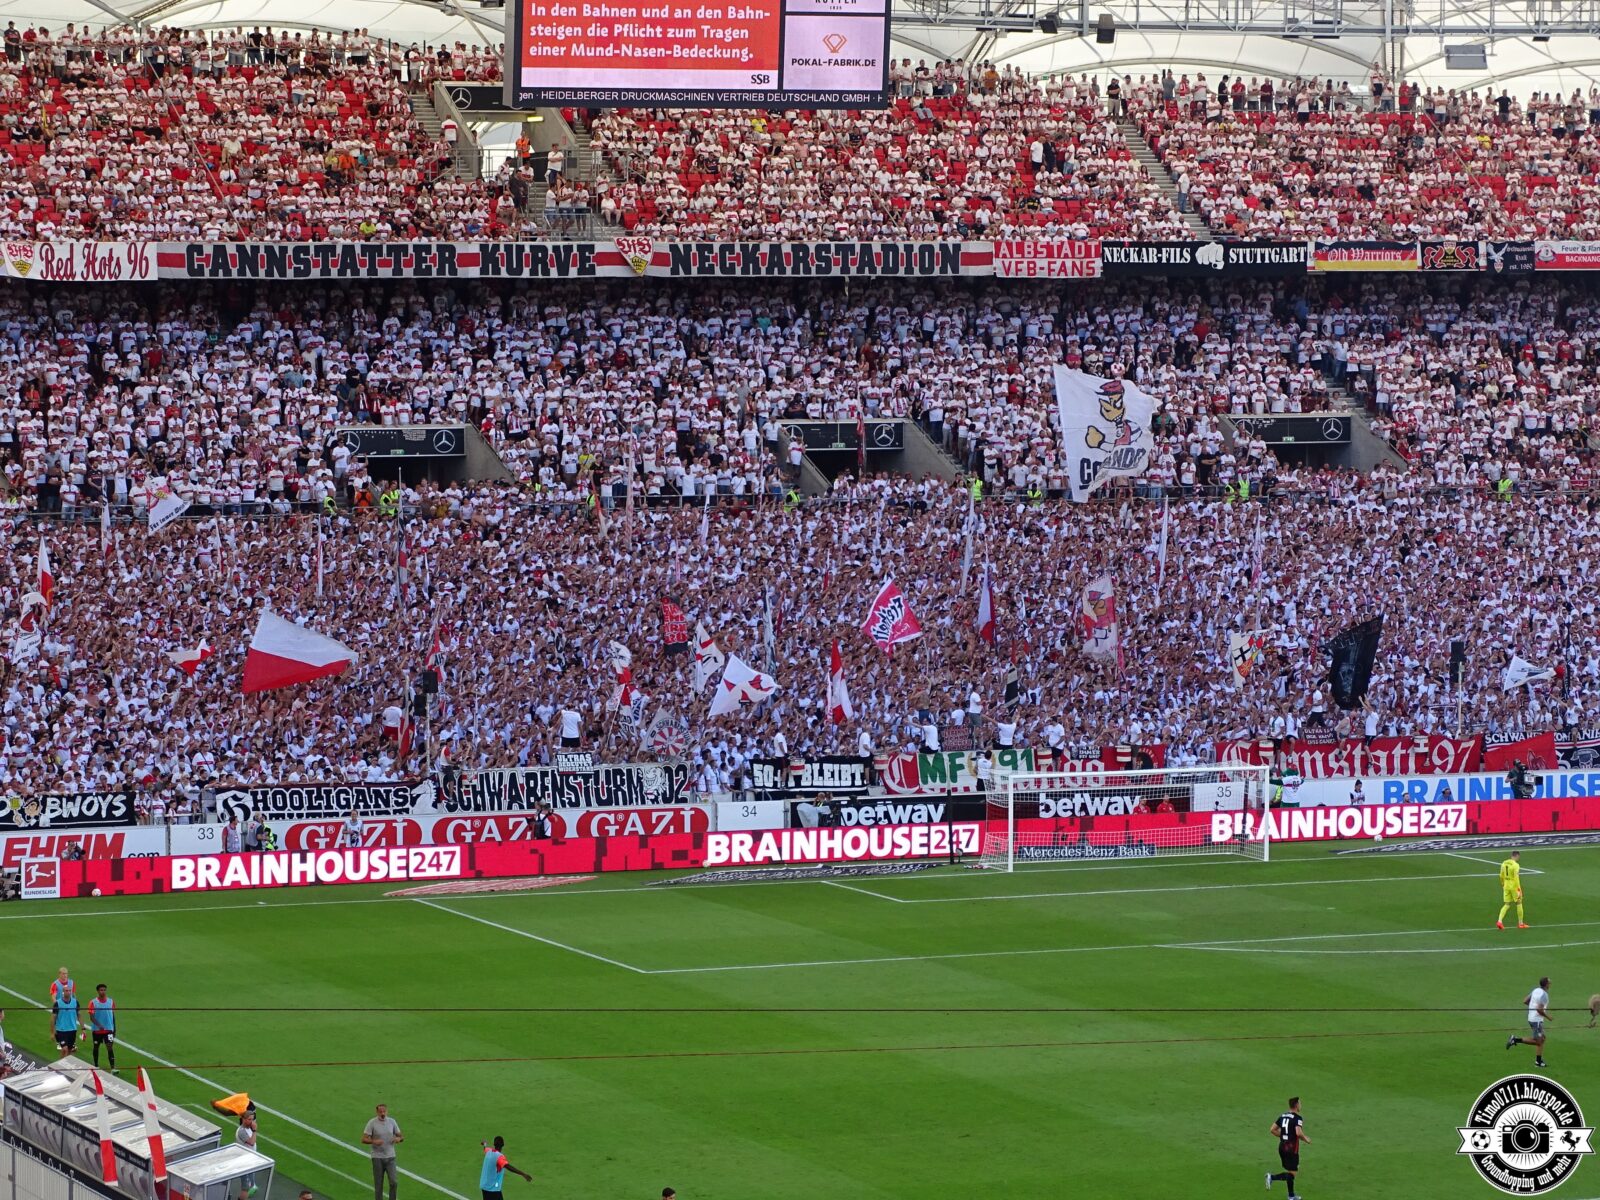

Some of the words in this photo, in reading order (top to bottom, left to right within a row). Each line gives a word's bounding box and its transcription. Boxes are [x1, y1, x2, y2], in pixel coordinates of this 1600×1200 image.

[531, 3, 546, 16] In
[550, 4, 579, 17] den
[582, 3, 637, 18] Bahnen
[641, 5, 669, 19] und
[674, 8, 692, 19] an
[696, 5, 723, 19] den
[727, 6, 771, 20] Bahn-
[530, 24, 583, 41] steigen
[587, 24, 610, 37] die
[613, 24, 663, 39] Pflicht
[667, 29, 697, 39] zum
[701, 26, 749, 43] Tragen
[529, 44, 567, 58] einer
[570, 44, 754, 61] Mund-Nasen-Bedeckung.
[791, 58, 877, 67] POKAL-FABRIK.DE
[750, 74, 770, 84] SSB
[541, 91, 618, 100] HEIDELBERGER
[621, 92, 715, 102] DRUCKMASCHINEN
[716, 92, 765, 102] VERTRIEB
[767, 93, 840, 102] DEUTSCHLAND
[842, 94, 870, 103] GMBH
[999, 241, 1098, 258] ALBSTADT
[1103, 245, 1191, 264] NECKAR-FILS
[1228, 246, 1306, 264] STUTTGART
[1327, 247, 1348, 262] Old
[1349, 247, 1402, 261] Warriors
[39, 243, 76, 280] Red
[81, 243, 122, 281] Hots
[127, 243, 149, 280] 96
[185, 243, 458, 278] CANNSTATTER
[479, 242, 596, 277] KURVE
[669, 242, 962, 277] NECKARSTADION
[1002, 259, 1096, 276] VFB-FANS
[556, 754, 592, 762] ULTRAS
[1004, 749, 1034, 772] 91
[1431, 738, 1476, 775] 97
[250, 787, 410, 812] HOOLIGANS
[1216, 786, 1232, 798] 35
[46, 793, 127, 819] BWOYS
[742, 806, 758, 818] 34
[1039, 792, 1143, 818] betway
[590, 807, 695, 837] GAZI
[1211, 806, 1418, 842] BRAINHOUSE
[1423, 808, 1464, 829] 247
[198, 828, 214, 840] 33
[2, 832, 126, 869] EHEIM
[708, 826, 928, 864] BRAINHOUSE
[1023, 846, 1115, 858] Mercedes-Benz
[1118, 845, 1150, 857] Bank
[171, 847, 408, 889] BRAINHOUSE
[412, 850, 456, 873] 247
[1282, 1118, 1290, 1134] 4
